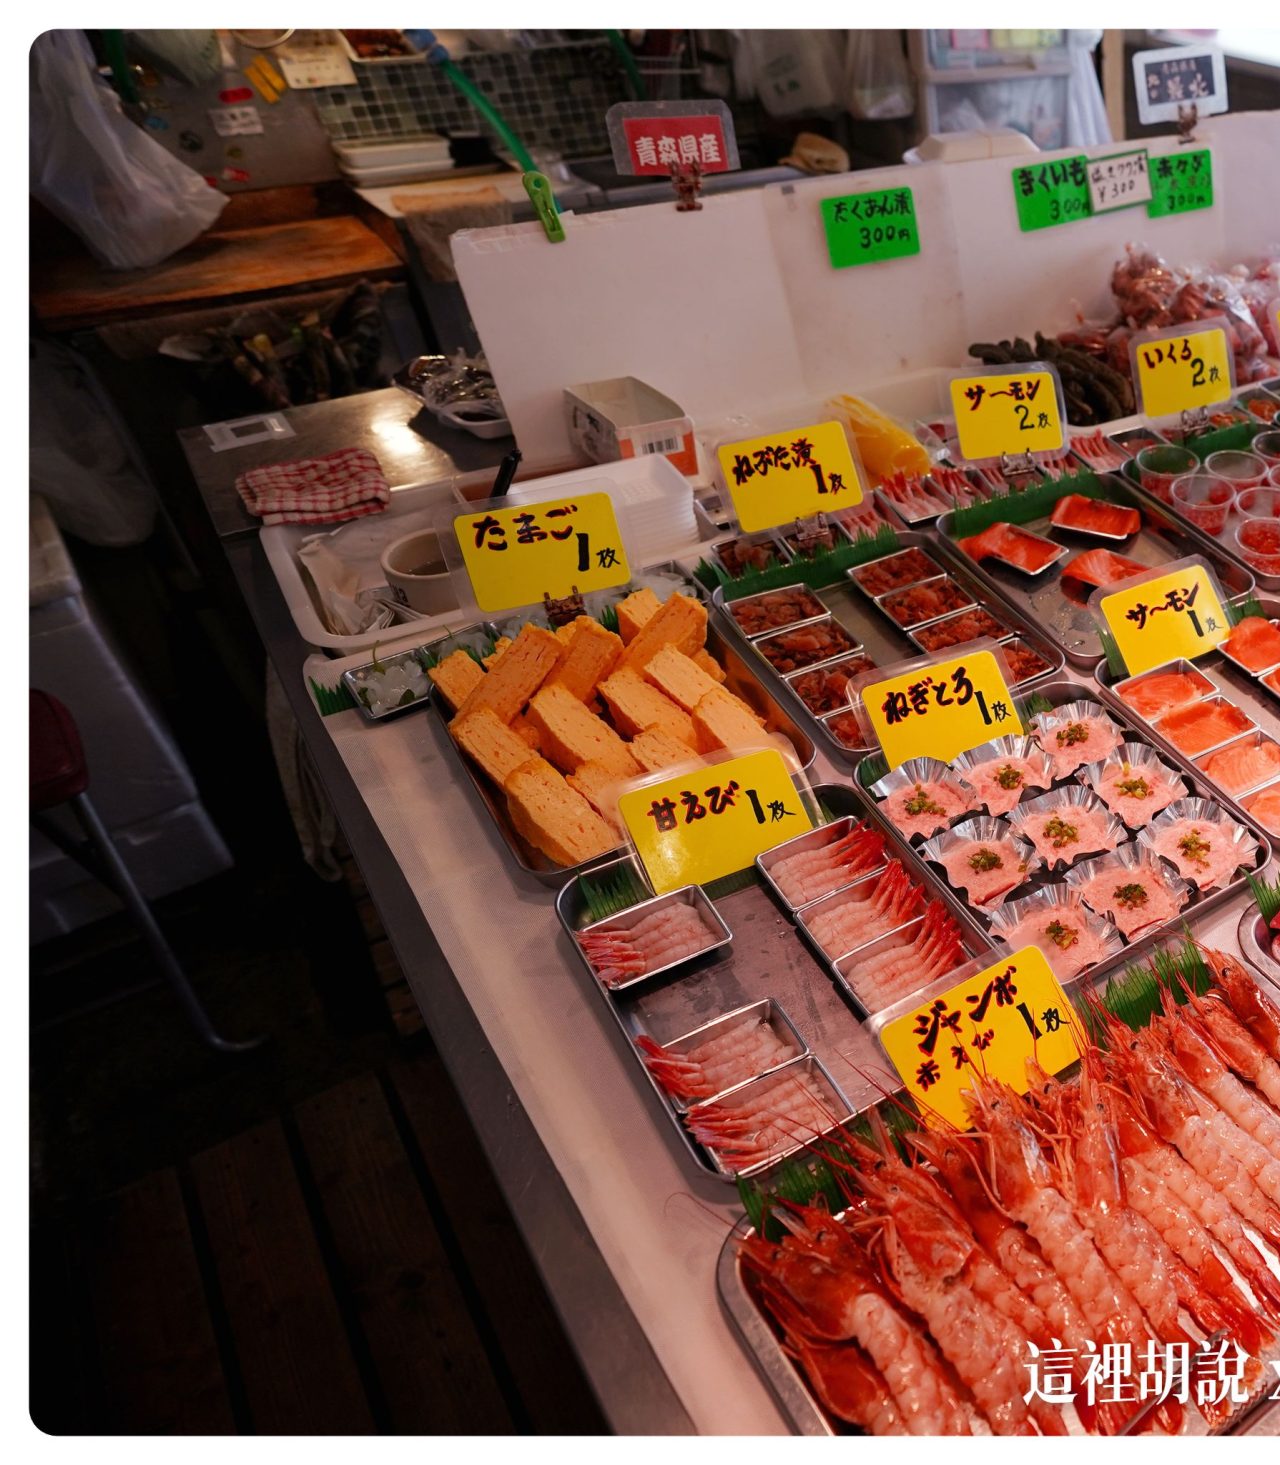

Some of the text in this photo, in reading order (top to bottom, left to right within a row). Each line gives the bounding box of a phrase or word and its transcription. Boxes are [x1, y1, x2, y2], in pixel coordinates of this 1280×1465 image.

[634, 133, 722, 166] 青森県産
[859, 225, 911, 249] 300円
[1143, 339, 1192, 369] いくら
[964, 379, 1041, 411] サーモン
[1014, 404, 1052, 430] 2枚
[732, 437, 817, 486] ねぶた漬
[810, 464, 848, 495] 1枚
[472, 504, 578, 551] たまご
[576, 533, 621, 572] 1枚
[1126, 582, 1199, 630] サーモン
[881, 666, 974, 725] ねぎとろ
[974, 690, 1012, 725] 1枚
[647, 780, 797, 833] 甘えび 1枚
[913, 965, 1018, 1057] ジャンボ
